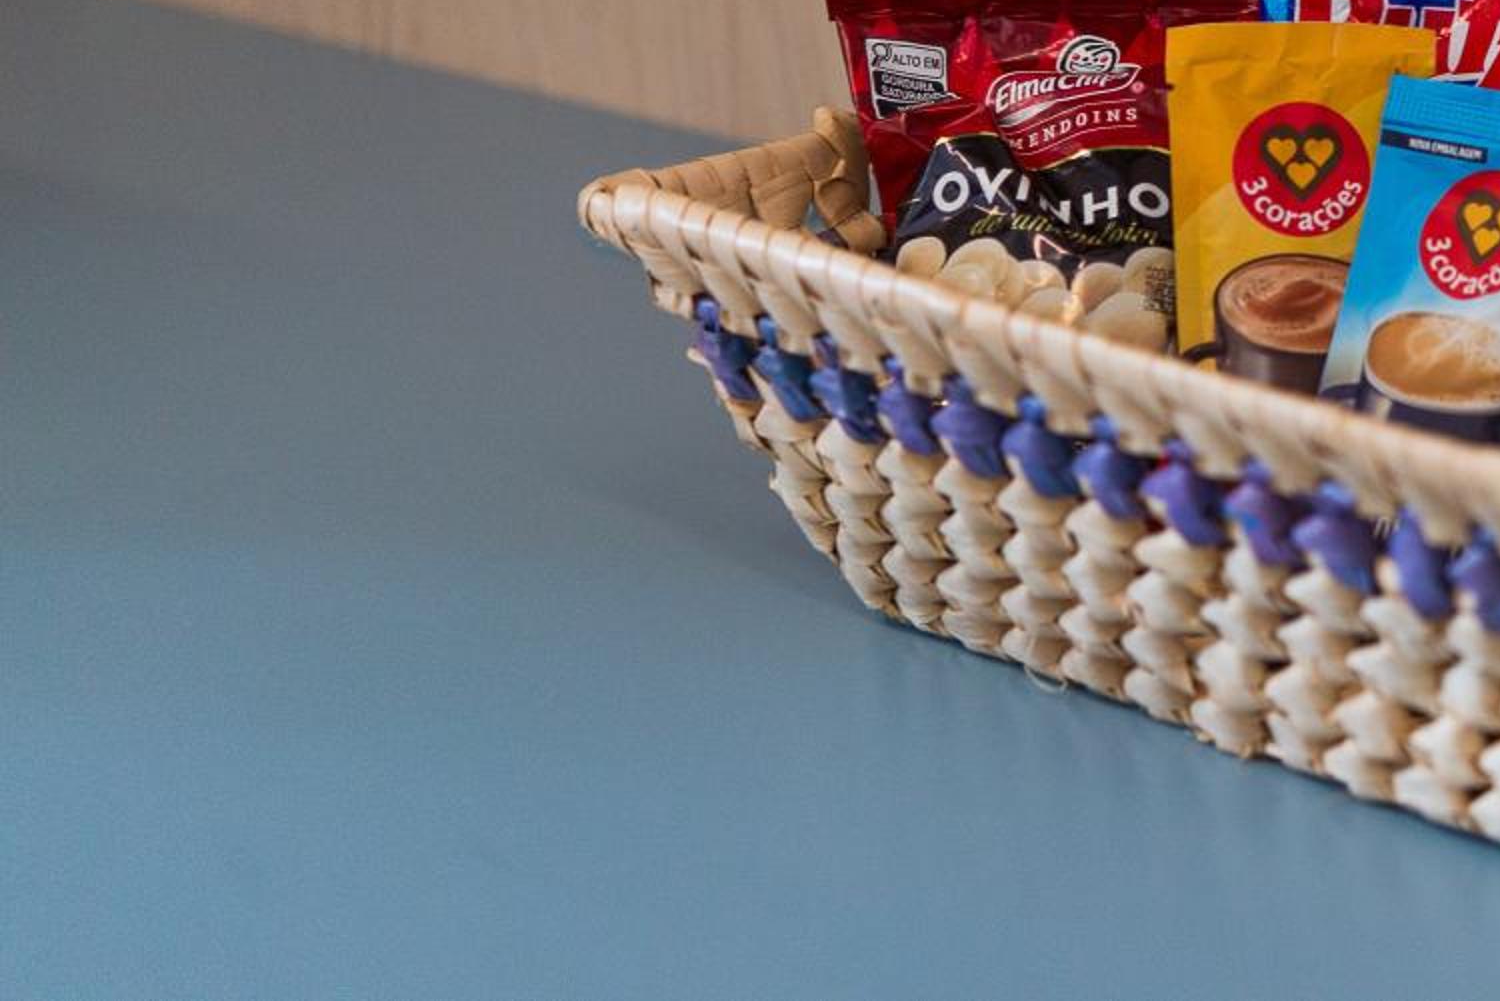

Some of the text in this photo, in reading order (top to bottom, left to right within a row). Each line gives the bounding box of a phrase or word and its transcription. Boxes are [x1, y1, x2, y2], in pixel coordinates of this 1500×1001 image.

[892, 54, 941, 70] ALTO EM
[1009, 108, 1138, 150] MENDOINS
[1241, 176, 1362, 232] 3 corações
[1425, 236, 1452, 253] 3
